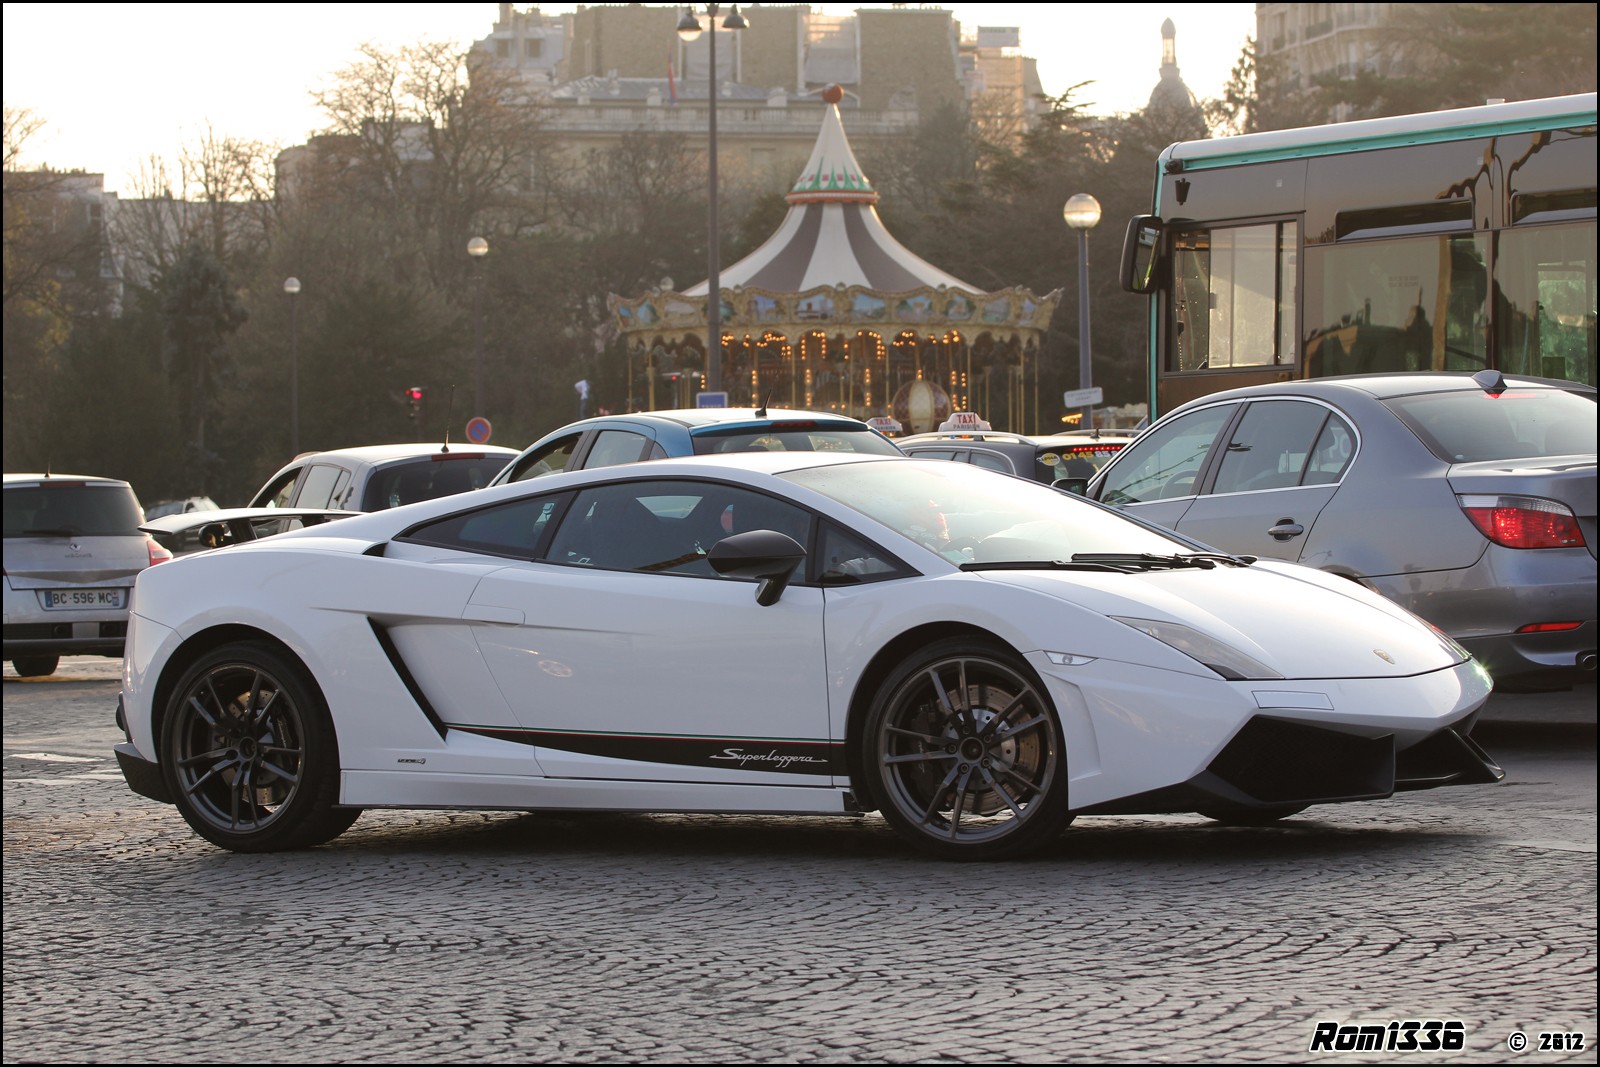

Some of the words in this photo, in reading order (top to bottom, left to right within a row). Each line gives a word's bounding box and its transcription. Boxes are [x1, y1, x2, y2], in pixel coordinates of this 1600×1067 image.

[957, 414, 976, 424] TAXI
[1062, 453, 1077, 461] 01
[1078, 451, 1094, 459] 45
[709, 748, 828, 768] Superleggera
